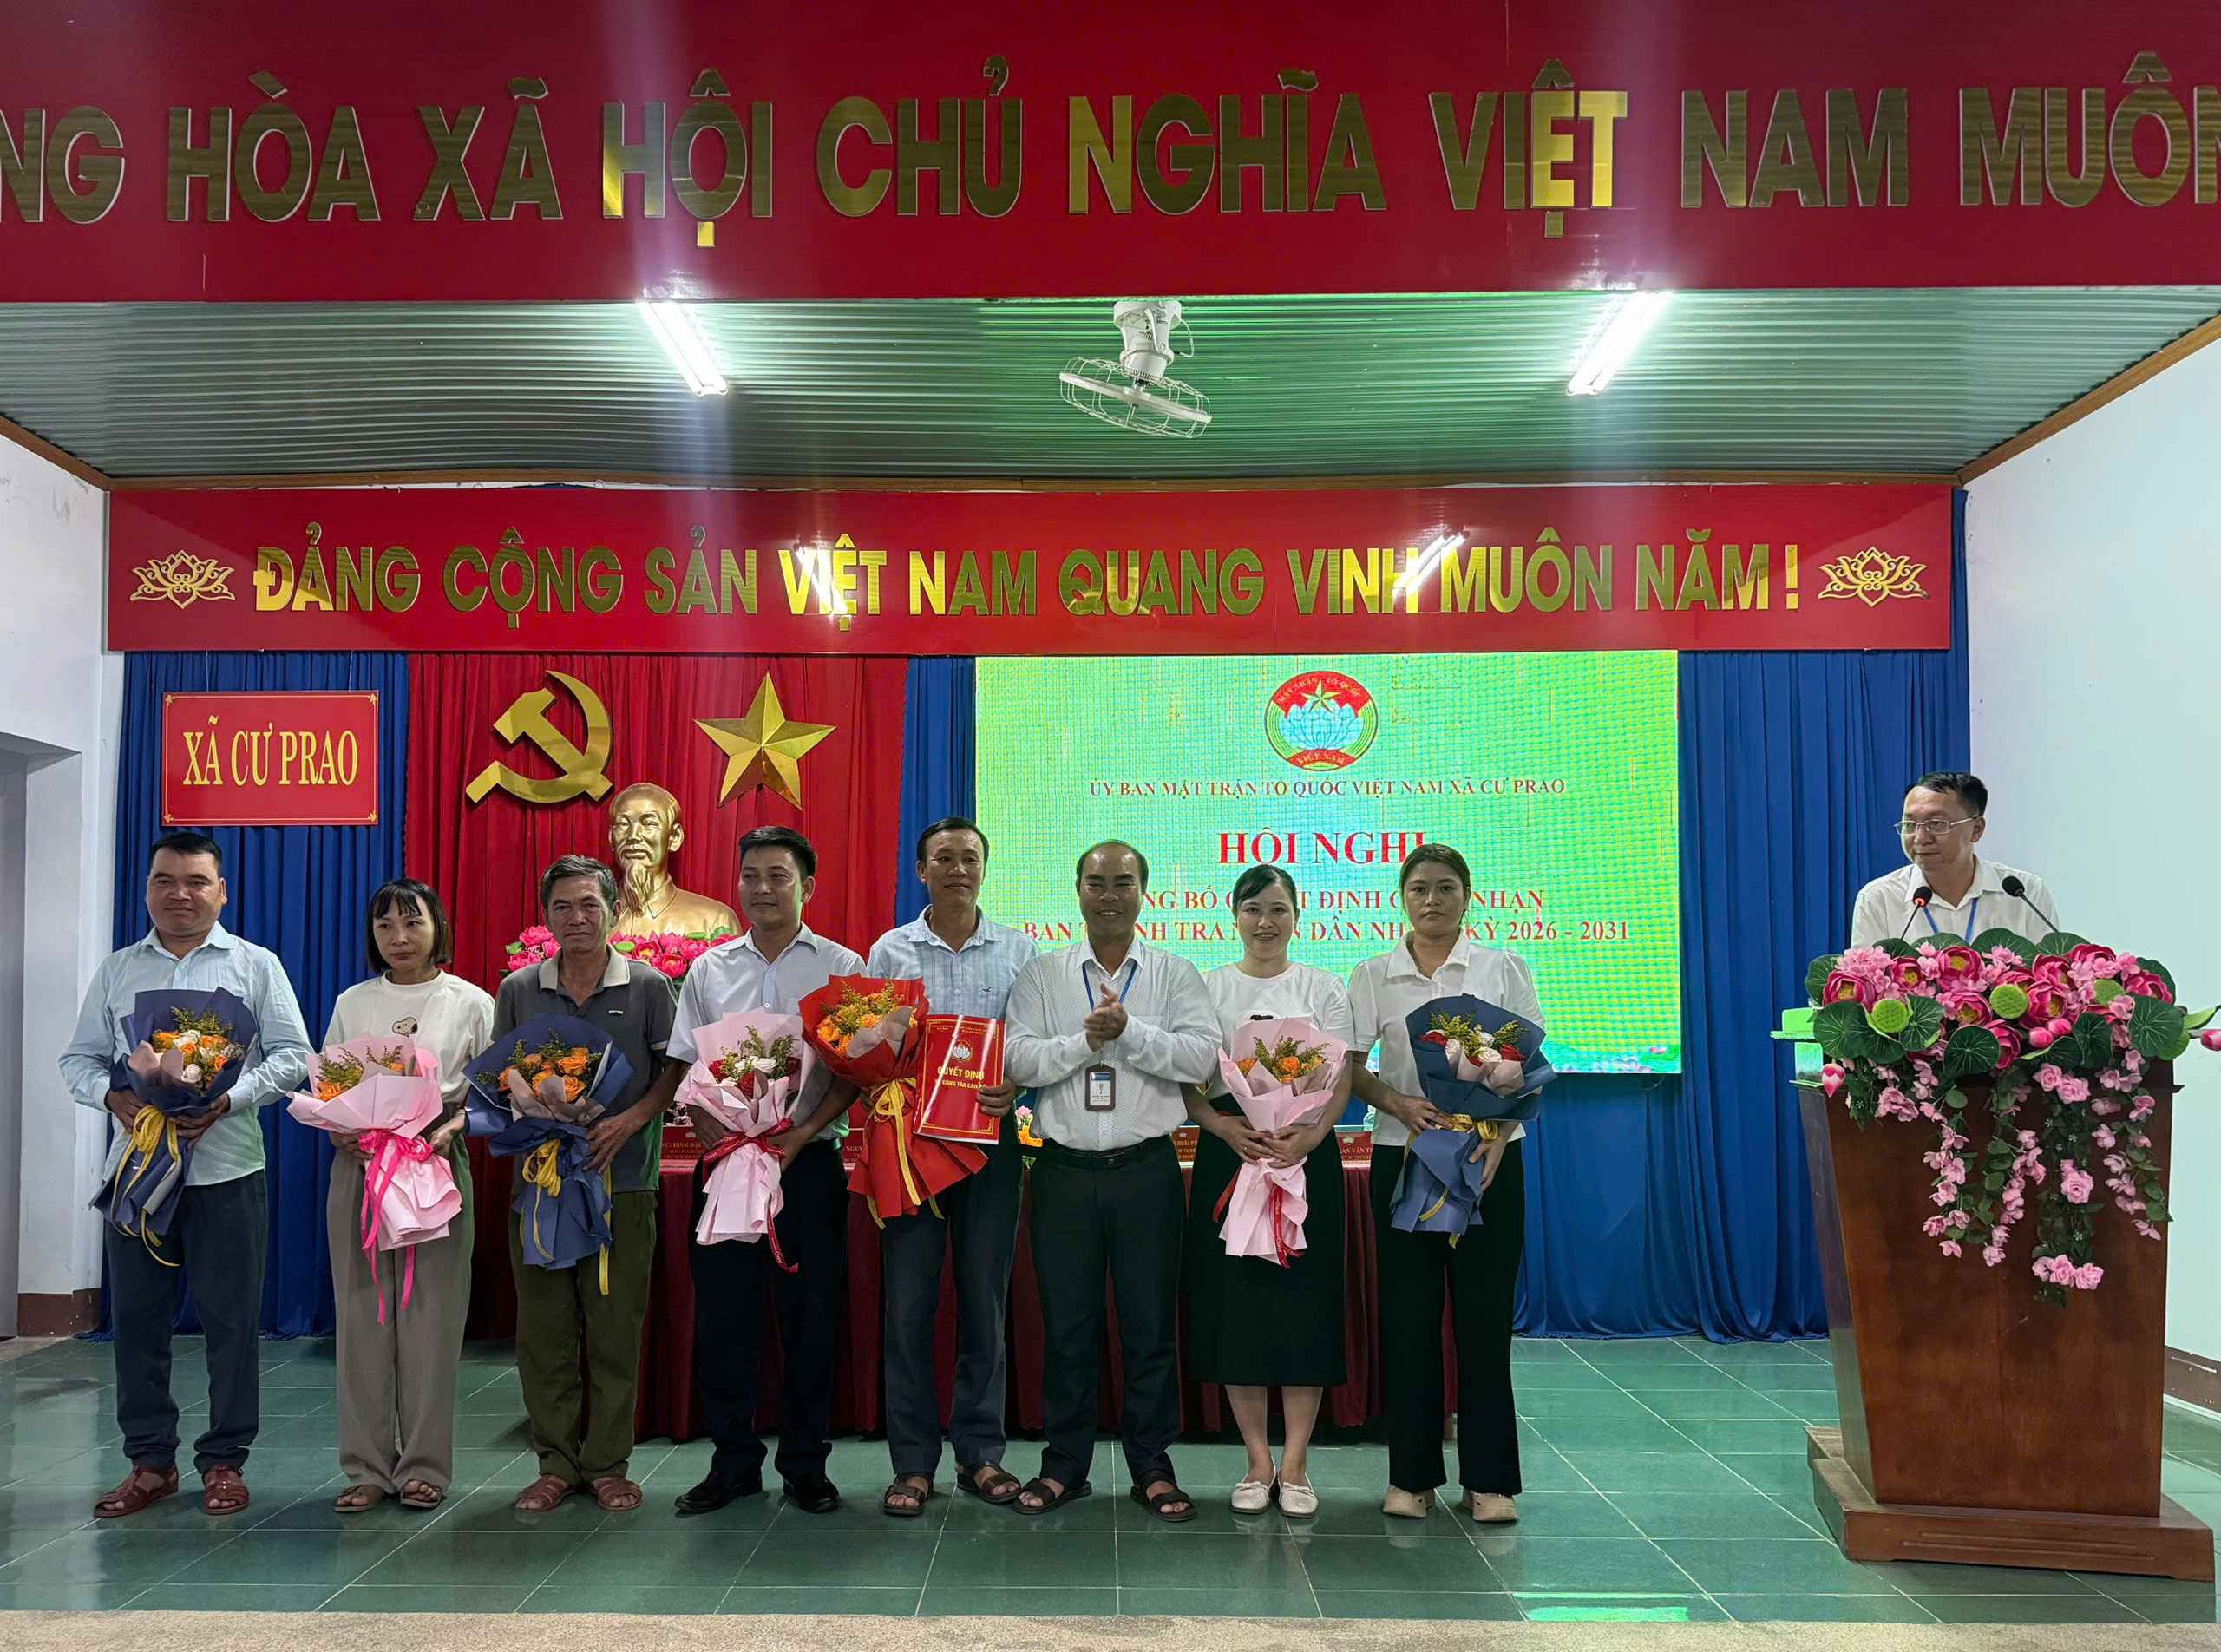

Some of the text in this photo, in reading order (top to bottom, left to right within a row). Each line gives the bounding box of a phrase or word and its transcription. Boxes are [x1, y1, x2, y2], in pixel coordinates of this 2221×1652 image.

[167, 69, 382, 223] HÒA
[413, 76, 563, 222] XÃ
[602, 68, 773, 249] HỘI
[816, 55, 1024, 218] CHỦ
[1067, 69, 1386, 217] NGHĨA
[1428, 59, 1628, 238] VIỆT
[1680, 88, 1909, 208] NAM
[252, 522, 422, 613] ĐẢNG
[442, 527, 625, 629] CỘNG
[644, 524, 757, 615] SẢN
[777, 534, 888, 632] VIỆT
[908, 550, 1038, 616] NAM
[1058, 547, 1263, 617] QUANG
[1286, 547, 1420, 614] VINH
[1439, 527, 1613, 613] MUÔN
[183, 715, 358, 786] XÃ CƯ PRAO
[1120, 782, 1156, 796] BAN
[1163, 779, 1202, 799] MẶT
[1207, 779, 1258, 799] TRẬN
[1293, 777, 1346, 798] QUỐC
[1352, 778, 1396, 798] VIỆT
[1401, 780, 1443, 794] NAM
[1450, 777, 1475, 795] XÃ
[1480, 777, 1510, 795] CƯ
[1513, 778, 1566, 794] PRAO
[1184, 885, 1218, 909] BỐ
[1319, 890, 1381, 914] ĐỊNH
[1471, 886, 1545, 914] NHẬN
[1025, 922, 1072, 940] BAN
[1174, 922, 1225, 941] TRA
[1310, 915, 1363, 940] DÂN
[1465, 915, 1500, 940] KỲ
[1508, 921, 1558, 940] 2026
[1579, 921, 1628, 940] 2031
